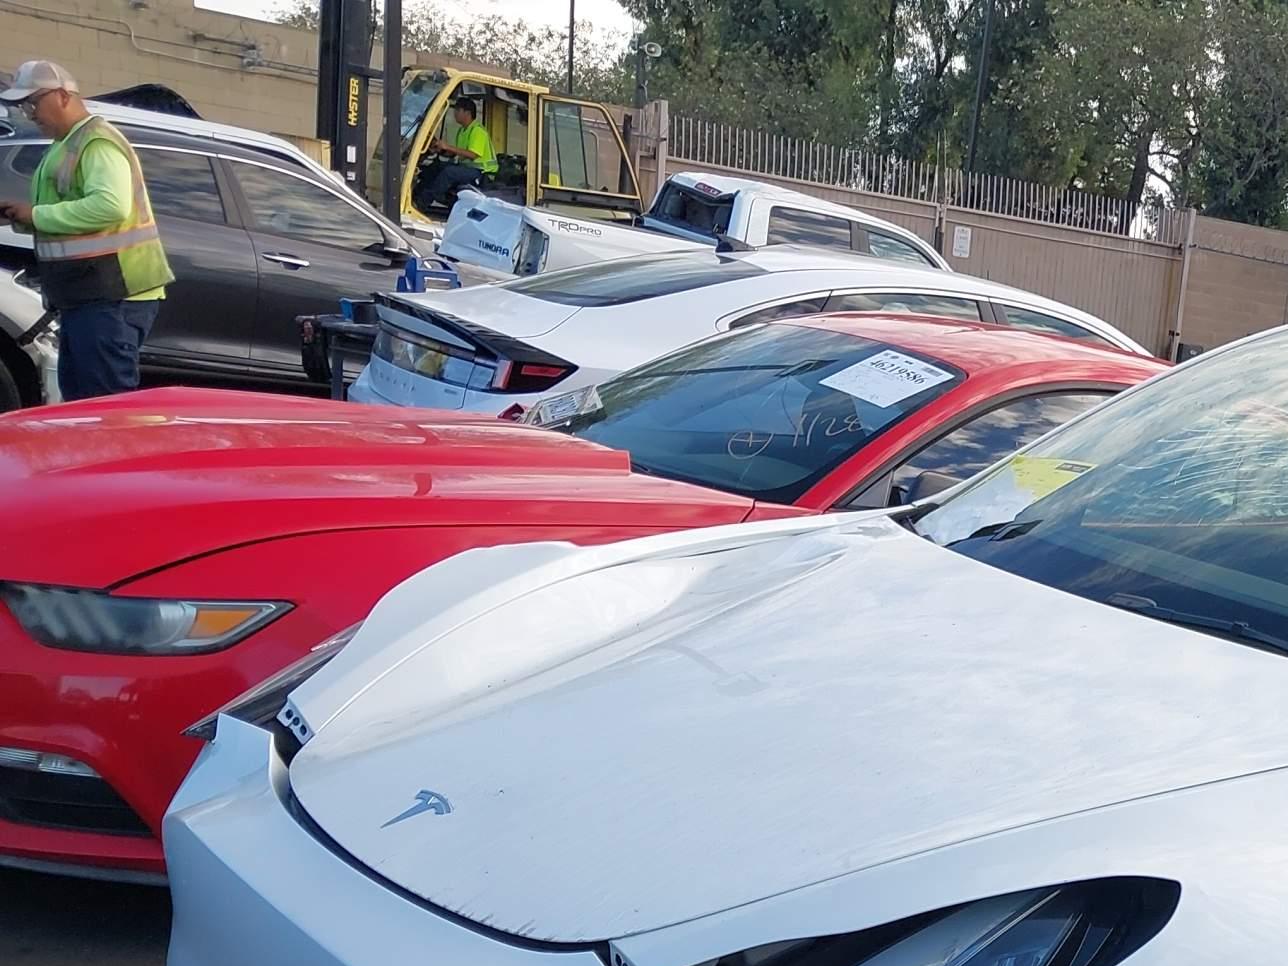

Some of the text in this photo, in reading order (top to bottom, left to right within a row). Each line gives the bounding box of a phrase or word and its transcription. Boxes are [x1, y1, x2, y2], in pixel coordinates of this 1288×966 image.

[347, 77, 359, 126] HYSTER
[477, 239, 510, 257] TUNDRA
[869, 358, 928, 385] 46219586
